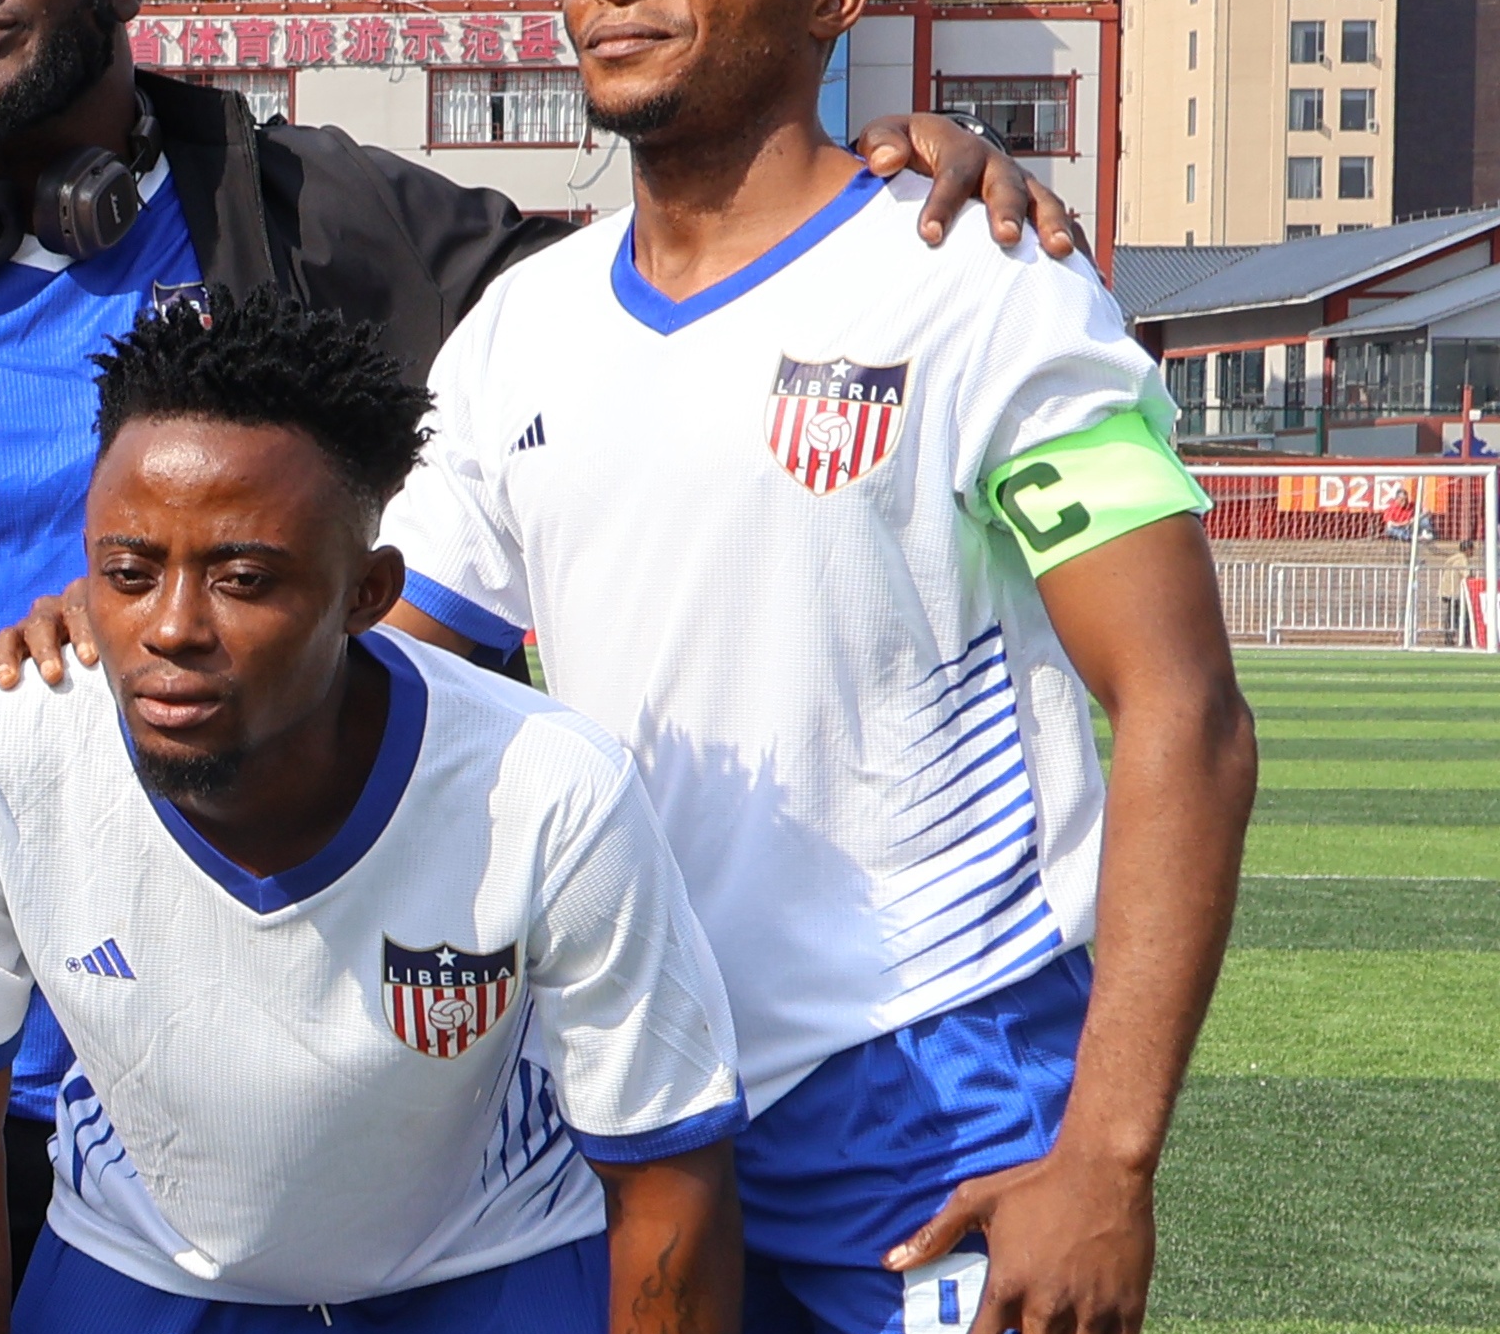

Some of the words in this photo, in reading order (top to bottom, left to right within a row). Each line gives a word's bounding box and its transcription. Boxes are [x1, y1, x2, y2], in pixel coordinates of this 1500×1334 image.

[126, 15, 562, 64] 省体育旅游示范县
[777, 378, 899, 403] LIBERIA
[1000, 462, 1091, 553] C
[388, 965, 512, 987] LIBERIA
